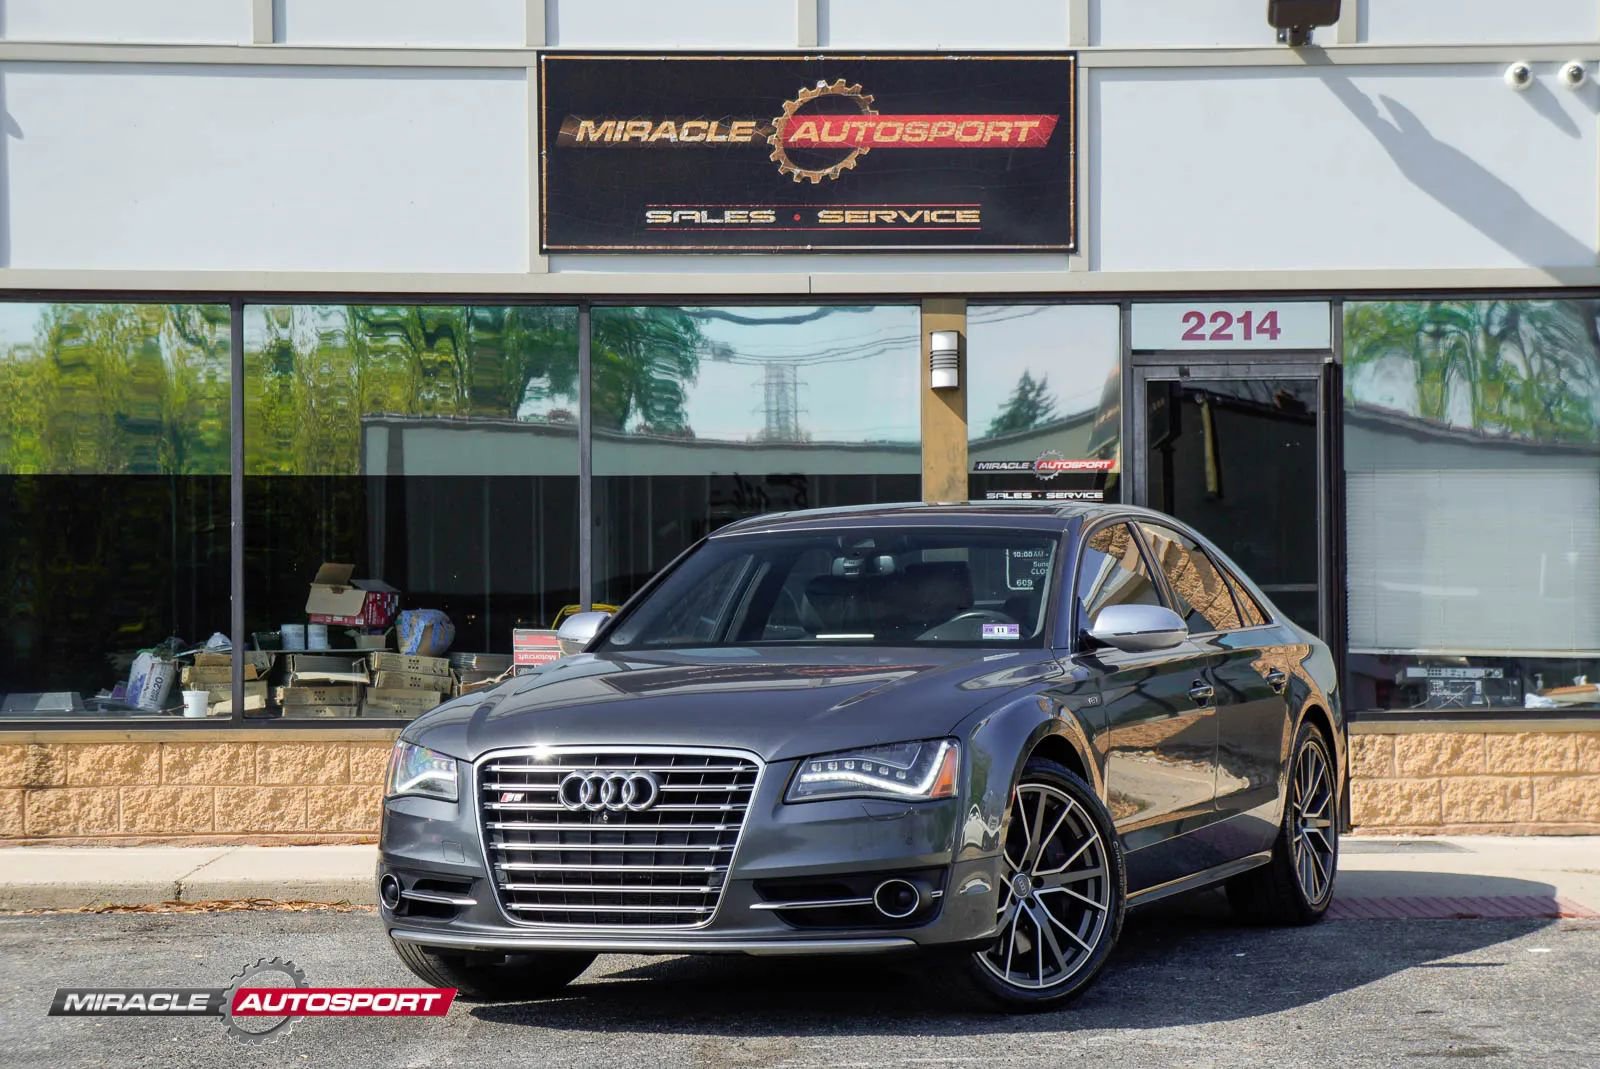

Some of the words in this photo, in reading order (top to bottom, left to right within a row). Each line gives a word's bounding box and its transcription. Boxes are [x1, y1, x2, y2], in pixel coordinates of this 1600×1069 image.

[575, 120, 757, 143] MIRACLE
[787, 120, 1041, 143] AUTOSPORT
[645, 209, 776, 224] SALES
[817, 209, 981, 224] SERVICE
[1181, 310, 1282, 341] 2214
[977, 462, 1031, 470] MIRACLE
[1039, 461, 1112, 469] AUTOSPORT
